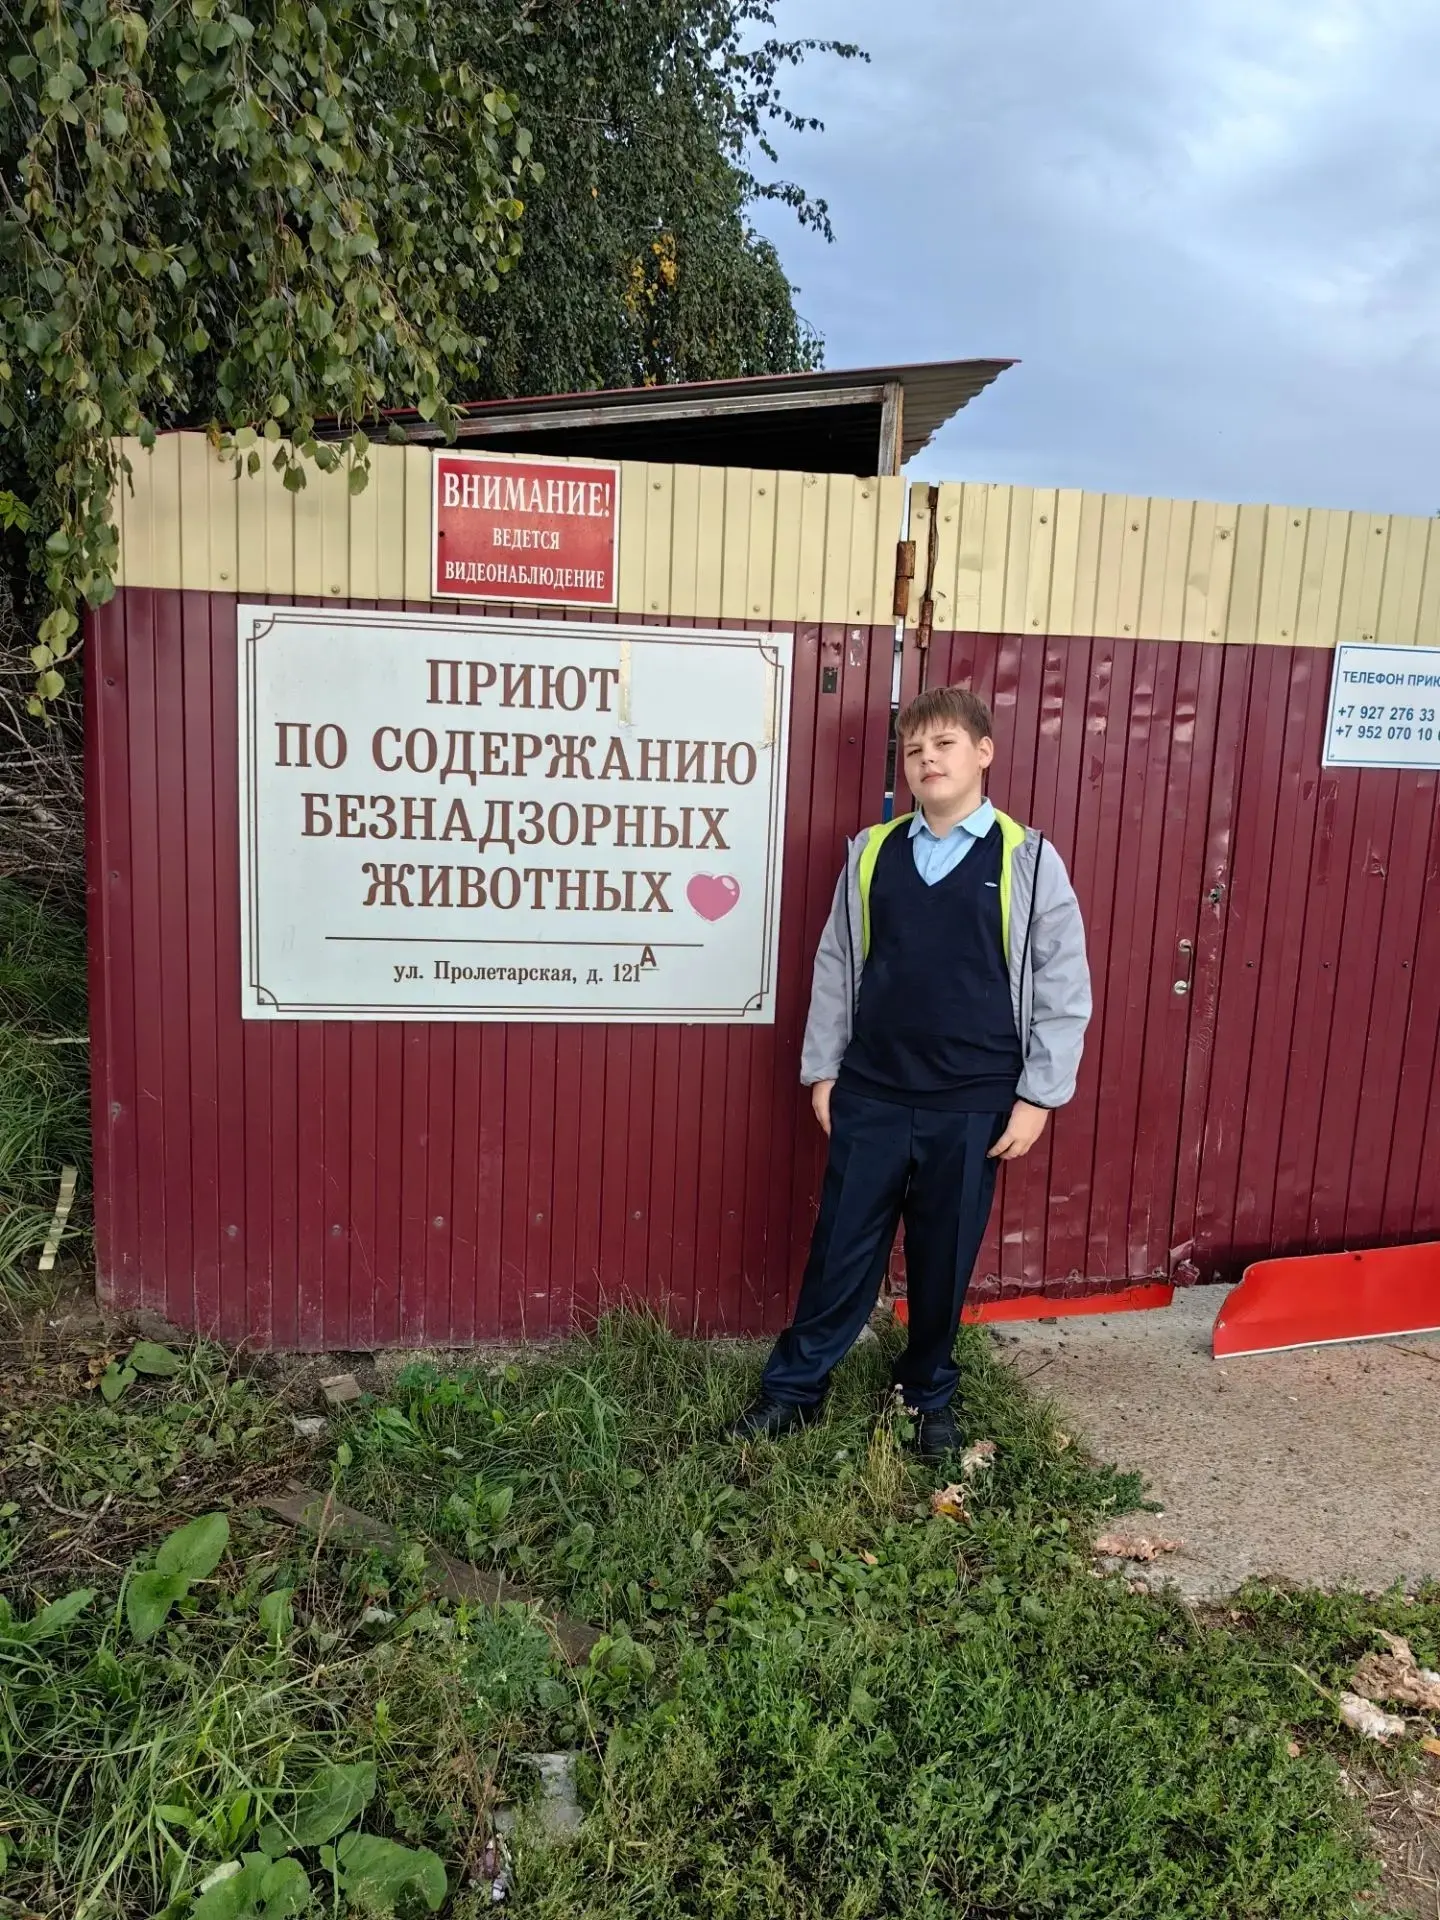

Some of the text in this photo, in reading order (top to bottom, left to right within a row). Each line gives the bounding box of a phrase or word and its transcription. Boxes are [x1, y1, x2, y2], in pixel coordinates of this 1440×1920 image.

[443, 472, 611, 518] ВНИМАНИЕ!
[492, 527, 561, 551] ВЕДЕТСЯ
[445, 560, 605, 589] ВИДЕОНАБЛЮДЕНИЕ
[426, 659, 620, 712] ПРИЮТ
[1343, 671, 1404, 686] ТЕЛЕФОН
[1338, 705, 1435, 722] +7 927 276 33
[1335, 725, 1353, 738] +7
[1358, 725, 1382, 739] 952
[1387, 726, 1411, 740] 070
[1417, 727, 1433, 741] 10
[274, 721, 758, 786] ПО СОДЕРЖАНИЮ
[300, 792, 731, 855] БЕЗНАДЗОРНЫХ
[361, 862, 674, 913] ЖИВОТНЫХ
[393, 965, 424, 982] ул.
[433, 960, 577, 985] Пролетарская,
[586, 969, 603, 984] д.
